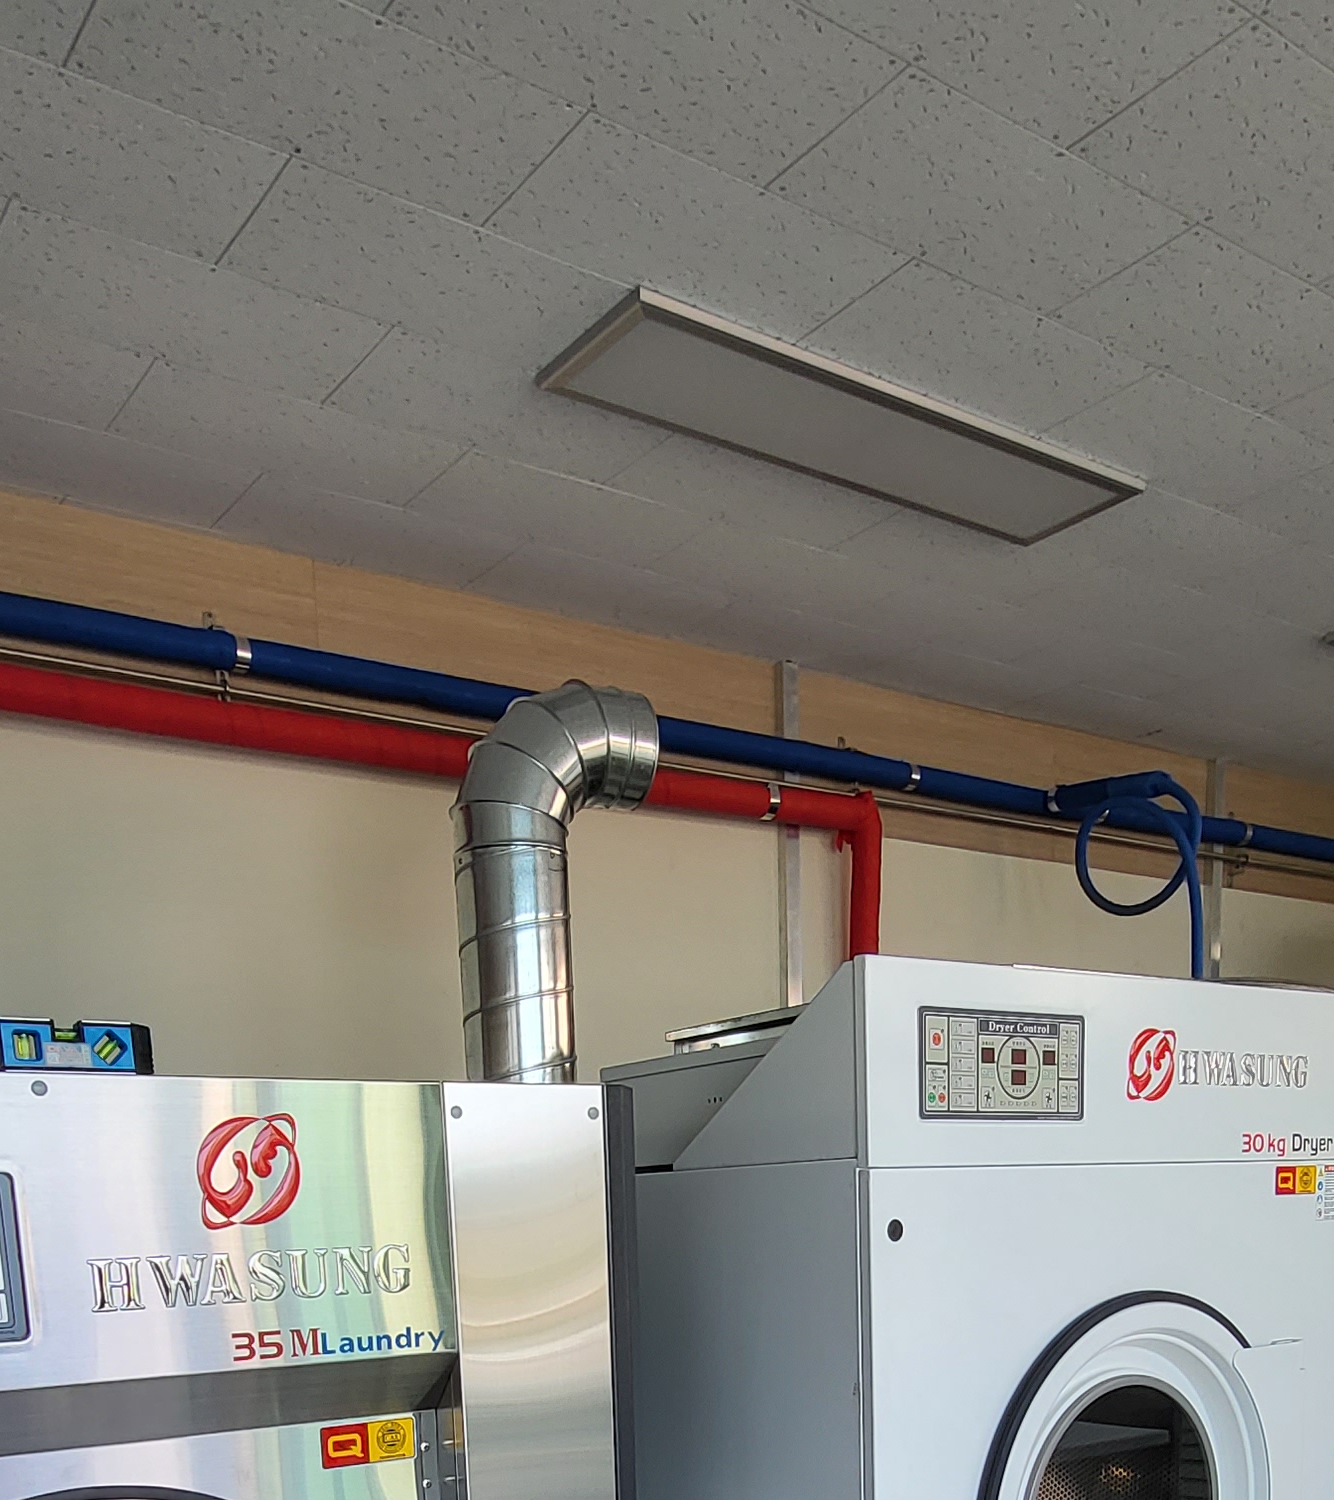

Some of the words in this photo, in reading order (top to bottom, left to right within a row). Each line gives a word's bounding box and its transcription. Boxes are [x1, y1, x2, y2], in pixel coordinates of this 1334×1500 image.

[988, 1021, 1014, 1033] Dryer
[1016, 1023, 1050, 1034] Control
[1177, 1049, 1308, 1088] HWASUNG
[1242, 1133, 1264, 1153] 30
[1267, 1133, 1286, 1156] kg
[1292, 1133, 1333, 1156] Dryer
[86, 1243, 411, 1313] HWASUNG
